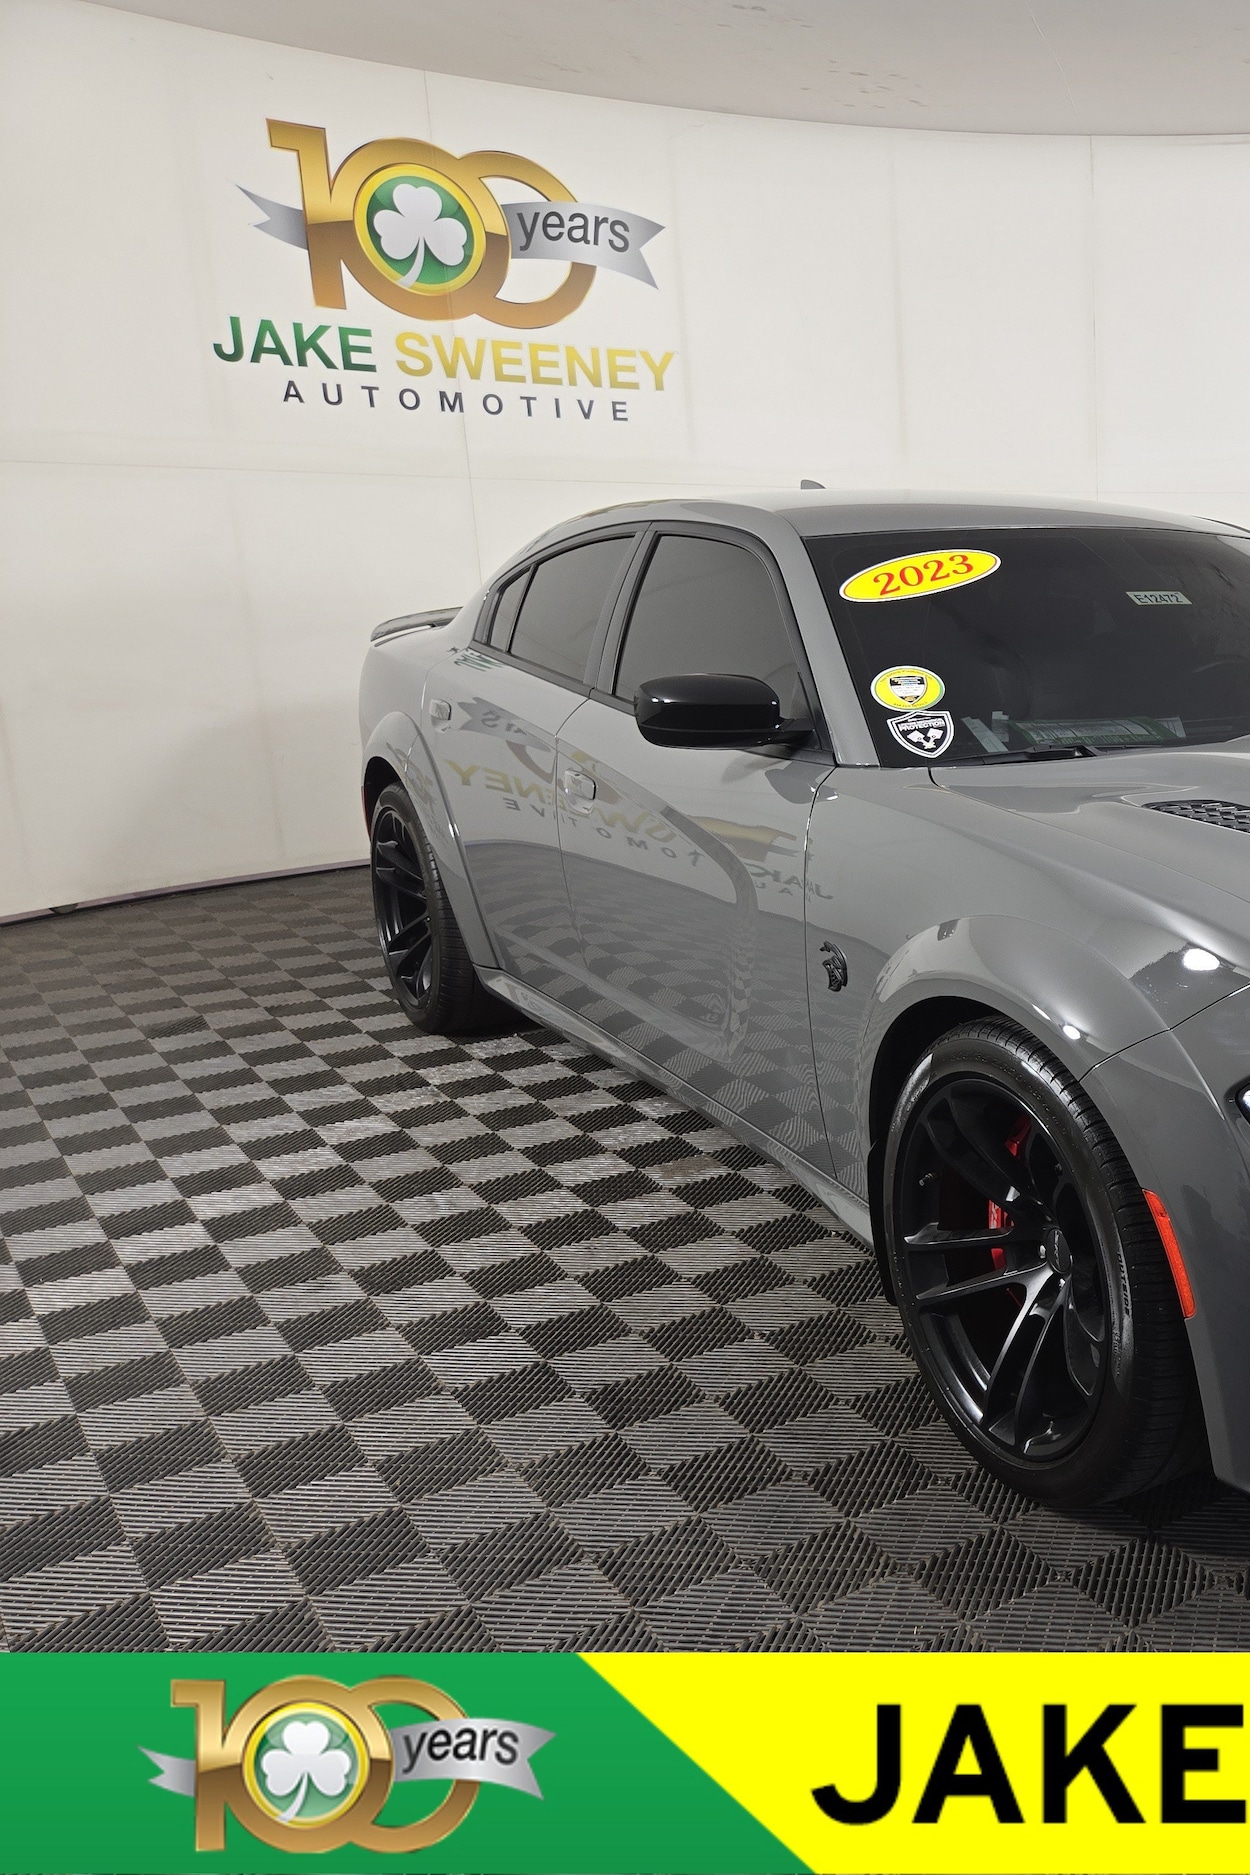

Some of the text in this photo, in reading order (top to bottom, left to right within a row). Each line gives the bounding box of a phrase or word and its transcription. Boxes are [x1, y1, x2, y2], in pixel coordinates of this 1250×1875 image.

[265, 117, 631, 330] 100 years
[212, 315, 675, 392] JAKE SWEENEY
[283, 380, 629, 422] AUTOMOTIVE
[873, 554, 974, 596] 2023
[1133, 594, 1183, 604] E12472
